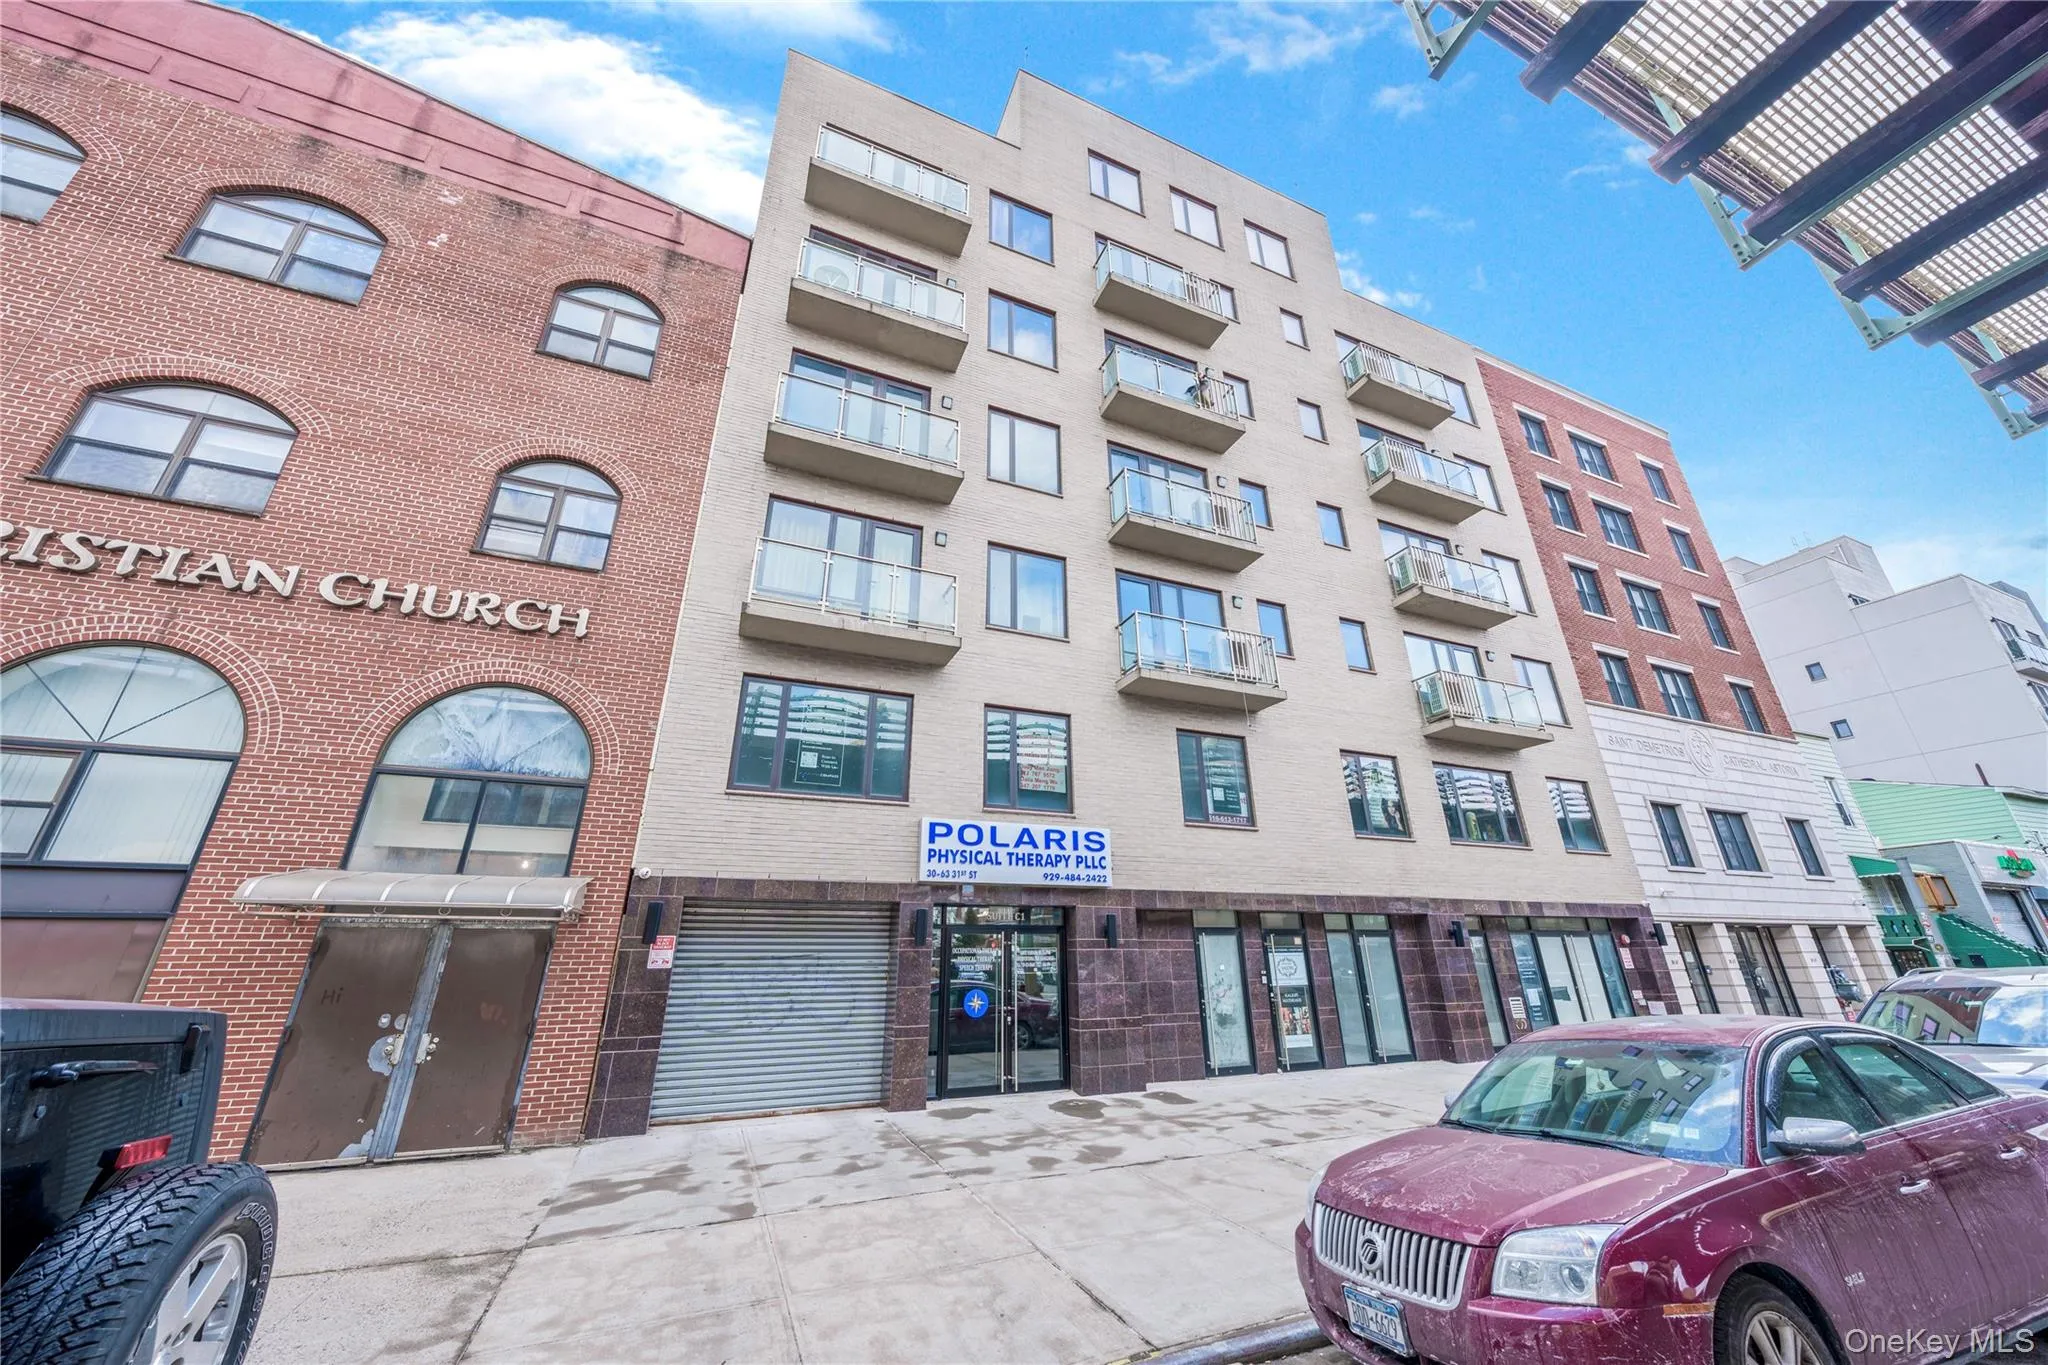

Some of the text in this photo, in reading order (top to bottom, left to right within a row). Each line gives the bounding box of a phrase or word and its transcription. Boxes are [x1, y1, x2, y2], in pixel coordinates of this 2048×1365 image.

[319, 572, 591, 639] CHURCH
[928, 821, 1106, 852] POLARIS
[927, 848, 1107, 870] PHYSICAL THERAPY PLLC
[927, 869, 950, 879] 30-63
[969, 870, 978, 879] ST
[1043, 872, 1107, 883] 929-484-2422
[1015, 912, 1025, 921] C1
[320, 987, 344, 1006] Hi
